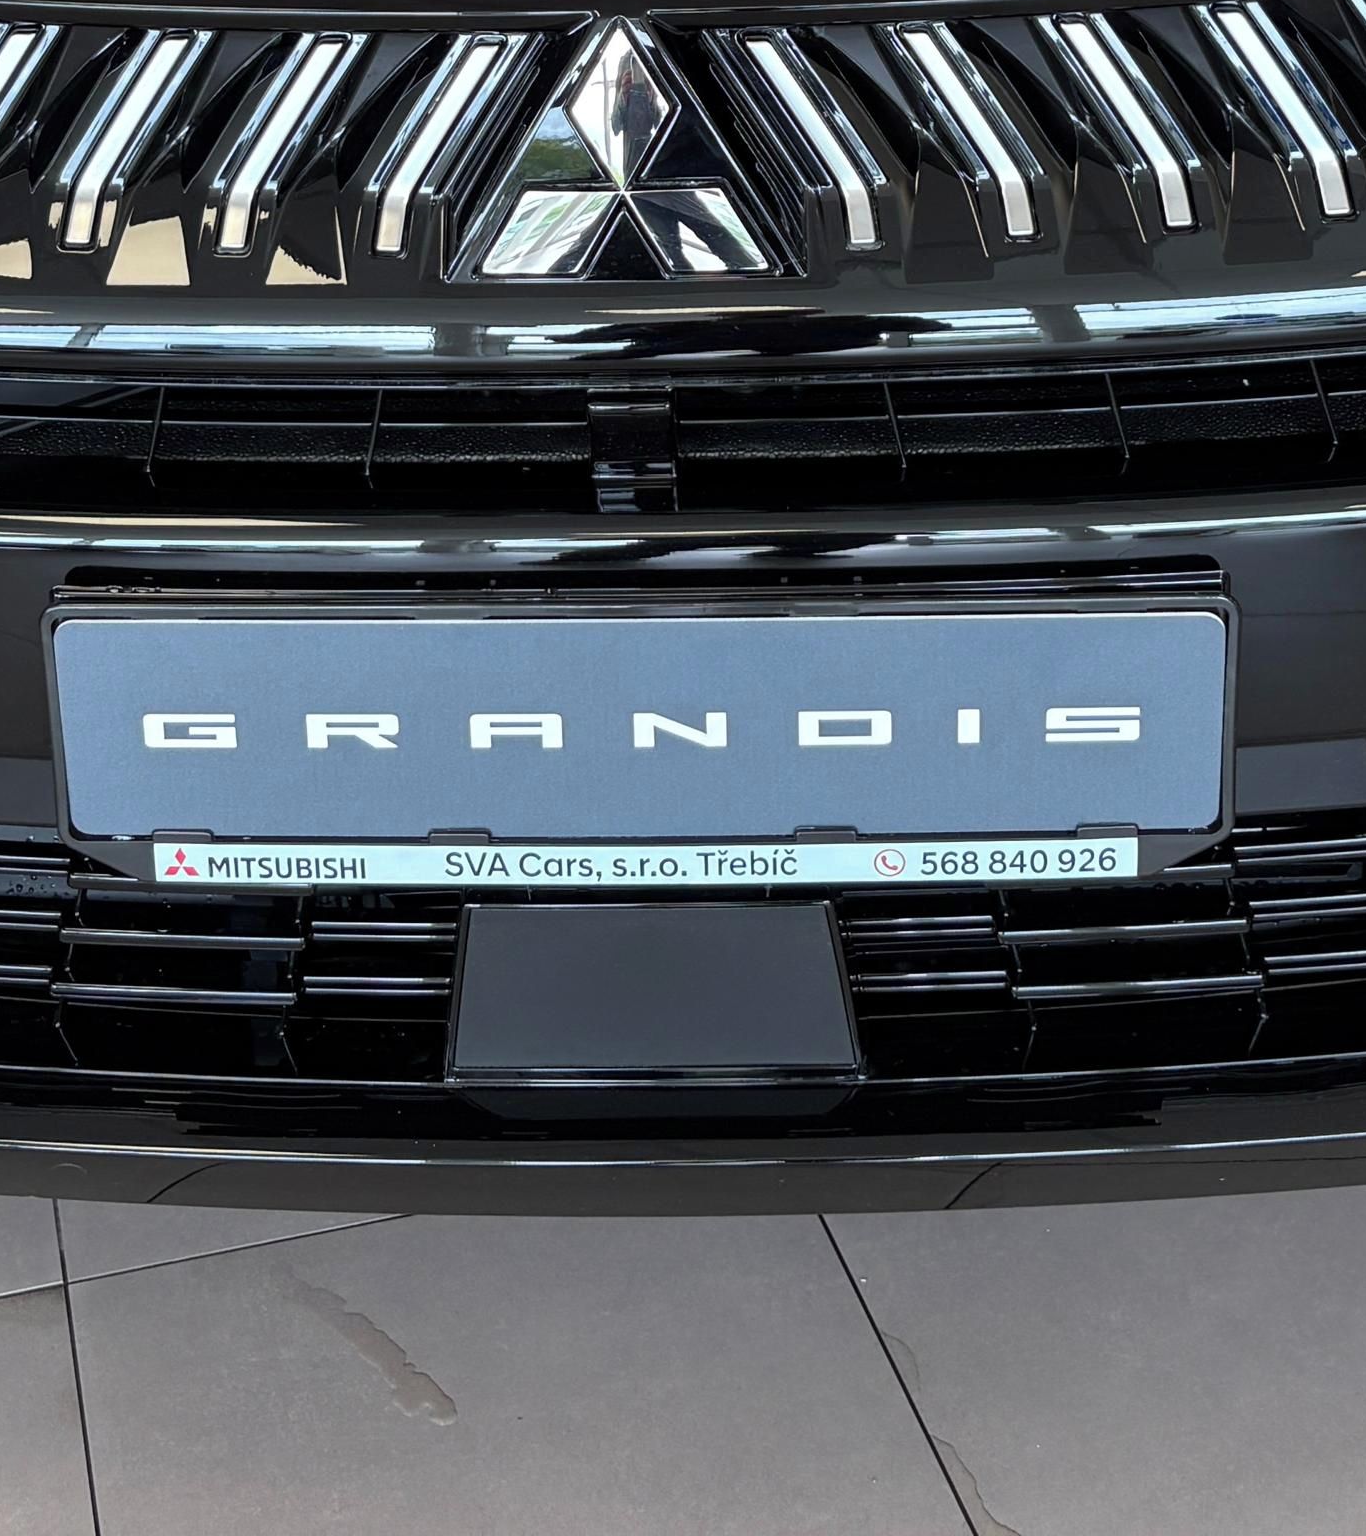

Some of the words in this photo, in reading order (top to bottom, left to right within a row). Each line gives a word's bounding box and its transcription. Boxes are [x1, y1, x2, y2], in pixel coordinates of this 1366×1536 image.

[142, 706, 1141, 749] GRANDIS
[207, 856, 367, 880] MITSUBISHI
[444, 851, 510, 878] SVA
[519, 852, 602, 882] Cars,
[612, 857, 688, 878] s.r.o.
[696, 850, 798, 877] Třebíč
[920, 851, 979, 876] 568
[988, 849, 1048, 875] 840
[1057, 847, 1117, 874] 926
